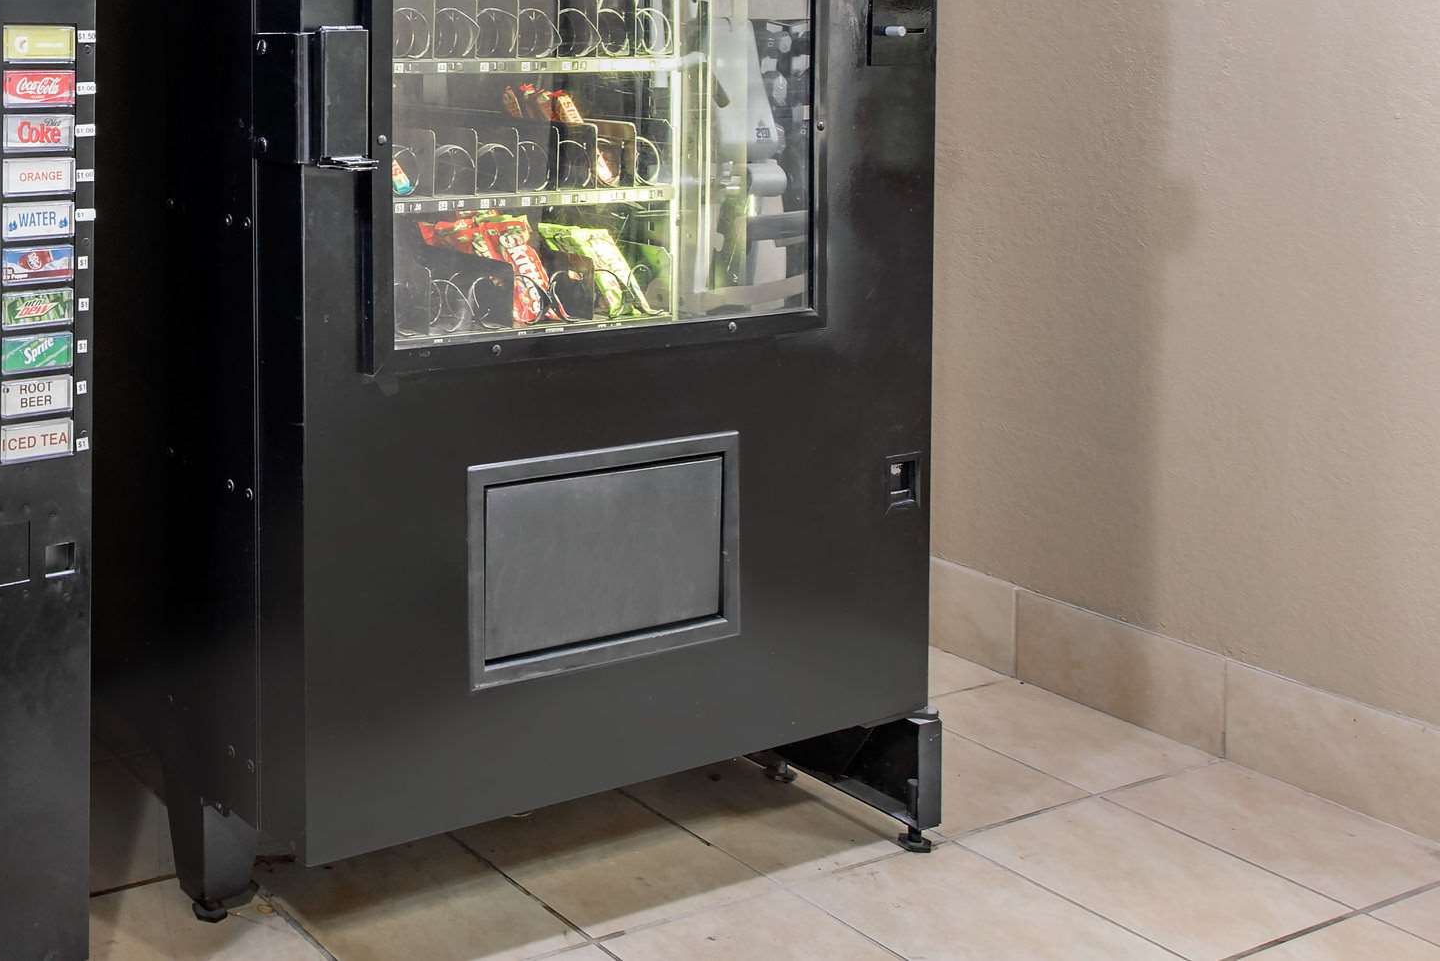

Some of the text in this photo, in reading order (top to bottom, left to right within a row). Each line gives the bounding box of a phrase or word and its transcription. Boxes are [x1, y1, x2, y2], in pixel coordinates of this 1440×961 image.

[17, 120, 62, 143] Coke
[19, 171, 63, 182] ORANGE
[18, 211, 57, 227] WATER
[24, 337, 54, 365] Sprite
[19, 382, 53, 395] ROOT
[20, 395, 53, 408] BEER
[2, 431, 68, 452] ICED TEA
